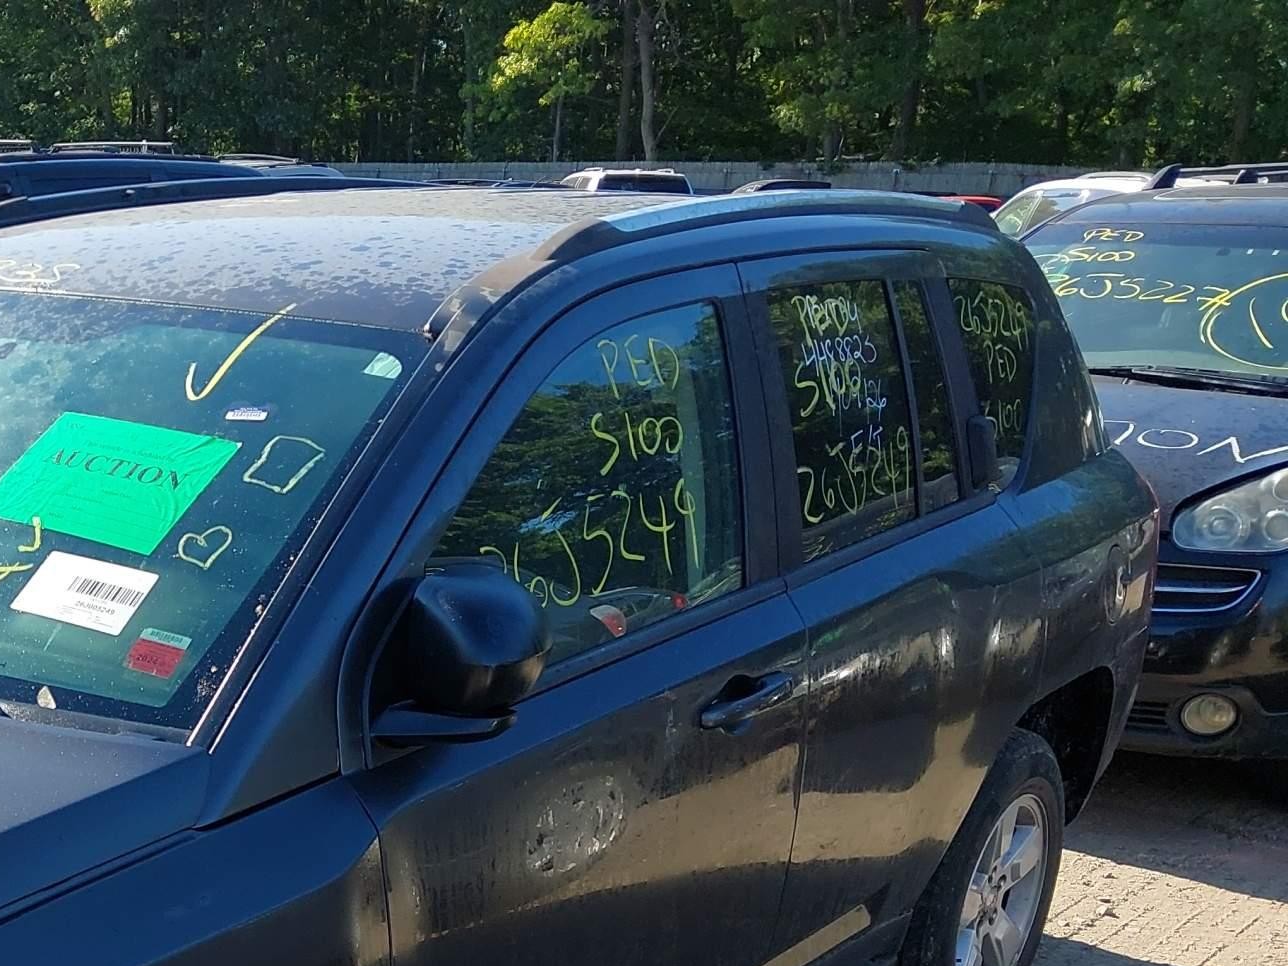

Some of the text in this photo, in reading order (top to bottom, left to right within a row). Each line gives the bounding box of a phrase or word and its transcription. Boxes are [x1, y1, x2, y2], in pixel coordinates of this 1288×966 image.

[1083, 228, 1145, 243] PED
[597, 334, 680, 400] PED
[983, 340, 1017, 384] PED
[591, 411, 684, 477] S100
[43, 447, 191, 491] AUCTION
